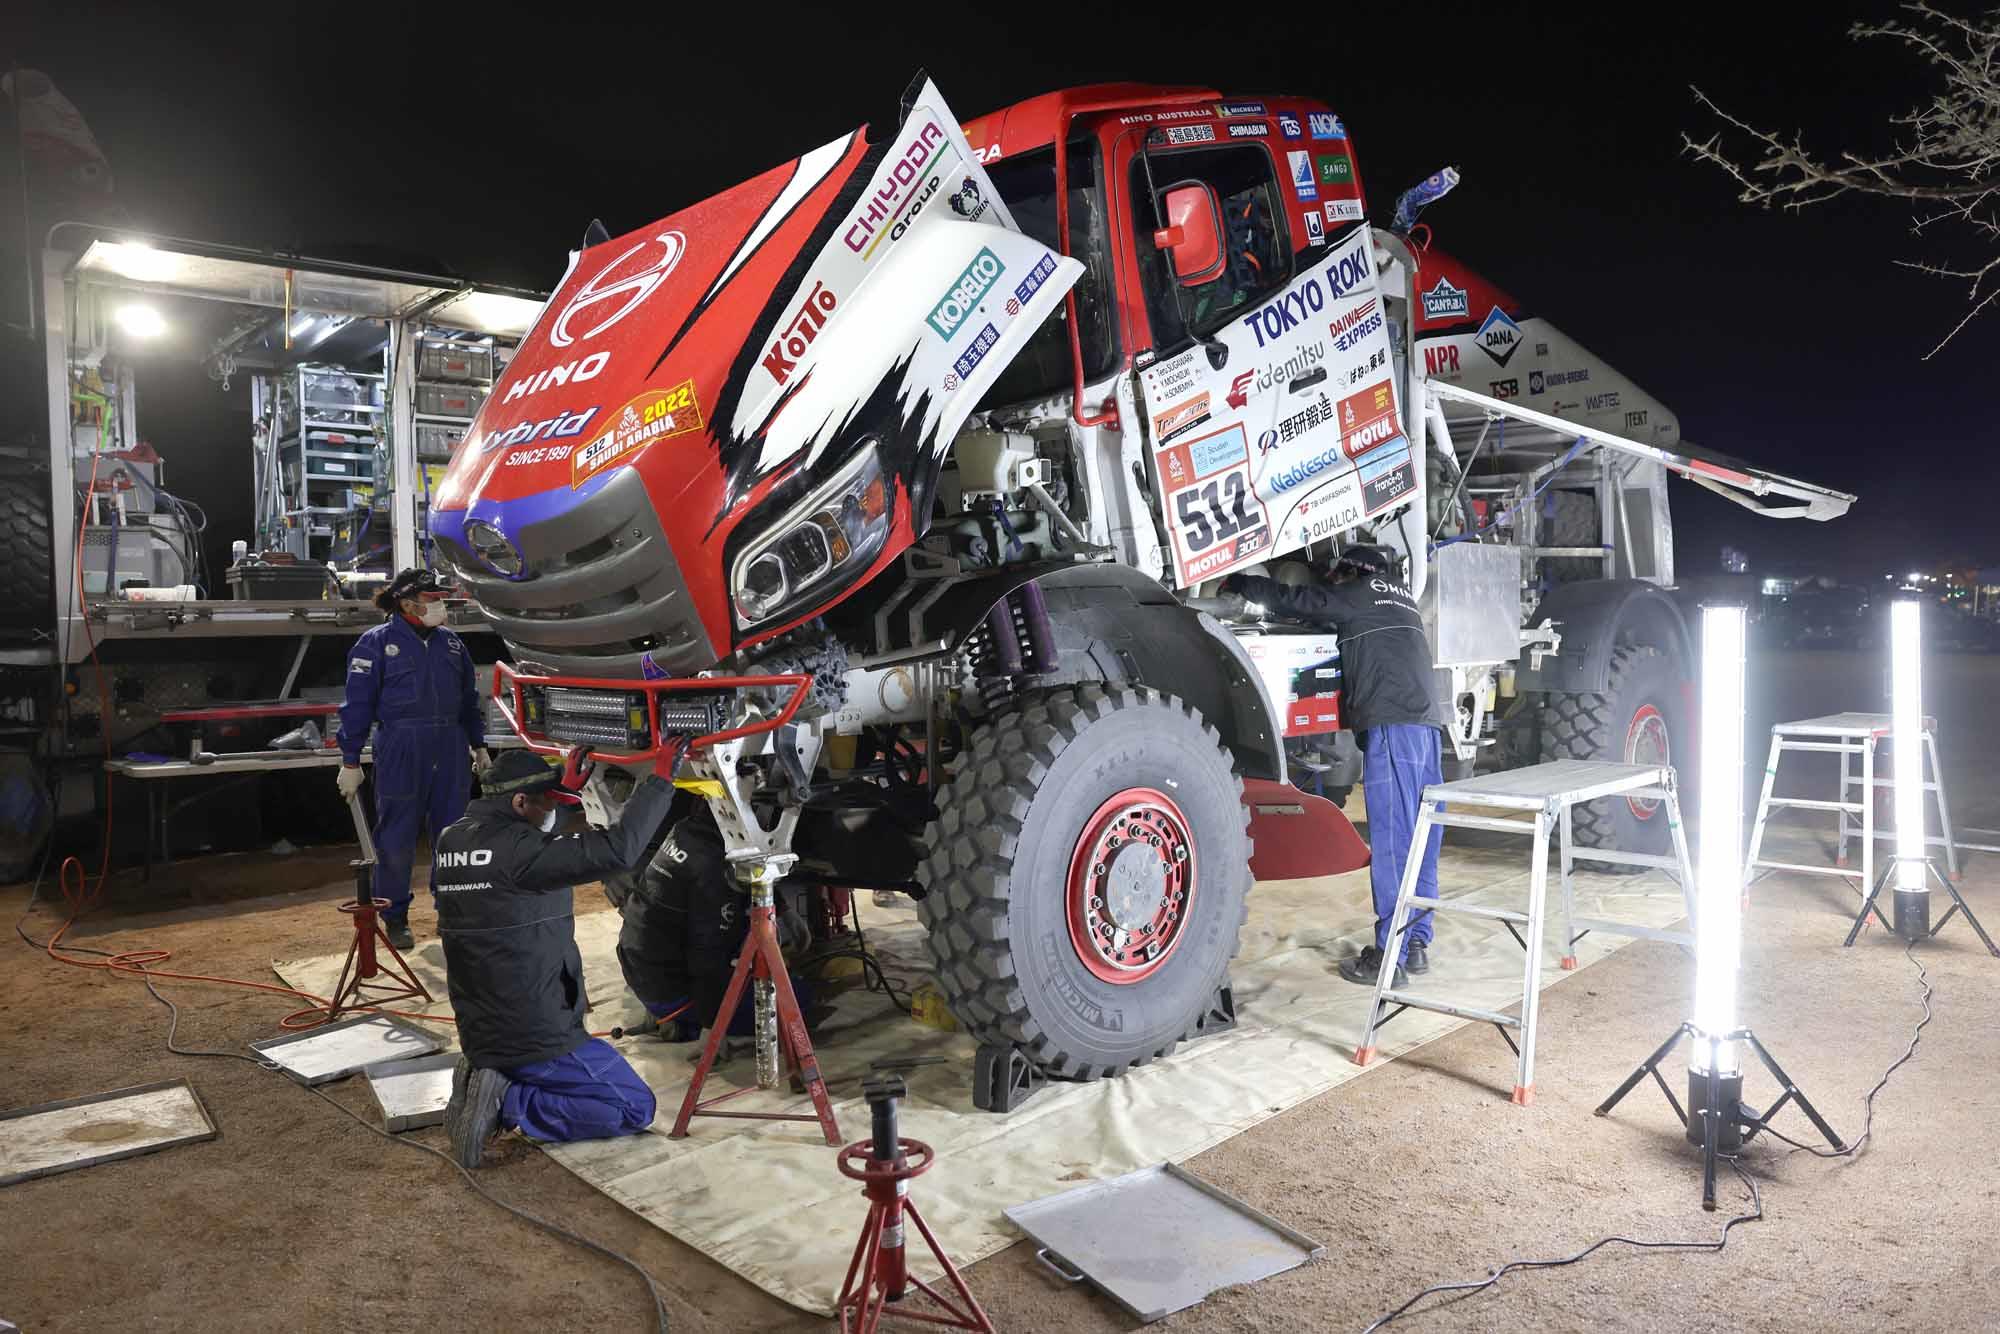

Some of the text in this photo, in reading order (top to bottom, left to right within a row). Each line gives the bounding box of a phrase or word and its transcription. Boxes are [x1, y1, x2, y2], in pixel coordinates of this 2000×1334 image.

[1120, 109, 1212, 125] HINO AUSTRALIA
[1231, 105, 1261, 114] MICHELIN
[1309, 114, 1344, 134] NOK
[1229, 124, 1268, 137] SHIMABUN
[1324, 164, 1347, 175] SANGO
[844, 121, 943, 252] CHIYODA
[890, 176, 940, 241] Group
[932, 255, 998, 334] KOBELCO
[1244, 246, 1370, 348] TOKYO ROKI
[1329, 307, 1361, 338] DAIWA
[1334, 312, 1382, 351] EXPRESS
[1486, 330, 1514, 346] DANA
[1256, 340, 1325, 392] idemitsu
[1424, 345, 1460, 375] NPR
[503, 352, 611, 404] HINO
[1490, 379, 1519, 399] TSB
[644, 388, 690, 423] 2022
[1279, 392, 1333, 444] 理研鍛造
[586, 438, 605, 459] 512
[589, 414, 676, 470] SAUDI ARABIA
[1350, 416, 1393, 452] MOTUL
[506, 445, 574, 466] SINCE 1991
[1270, 447, 1338, 493] Nabtesco
[1176, 471, 1260, 552] 512
[1313, 506, 1359, 537] QUALICA
[1188, 547, 1233, 578] MOTUL
[438, 849, 493, 868] HINO
